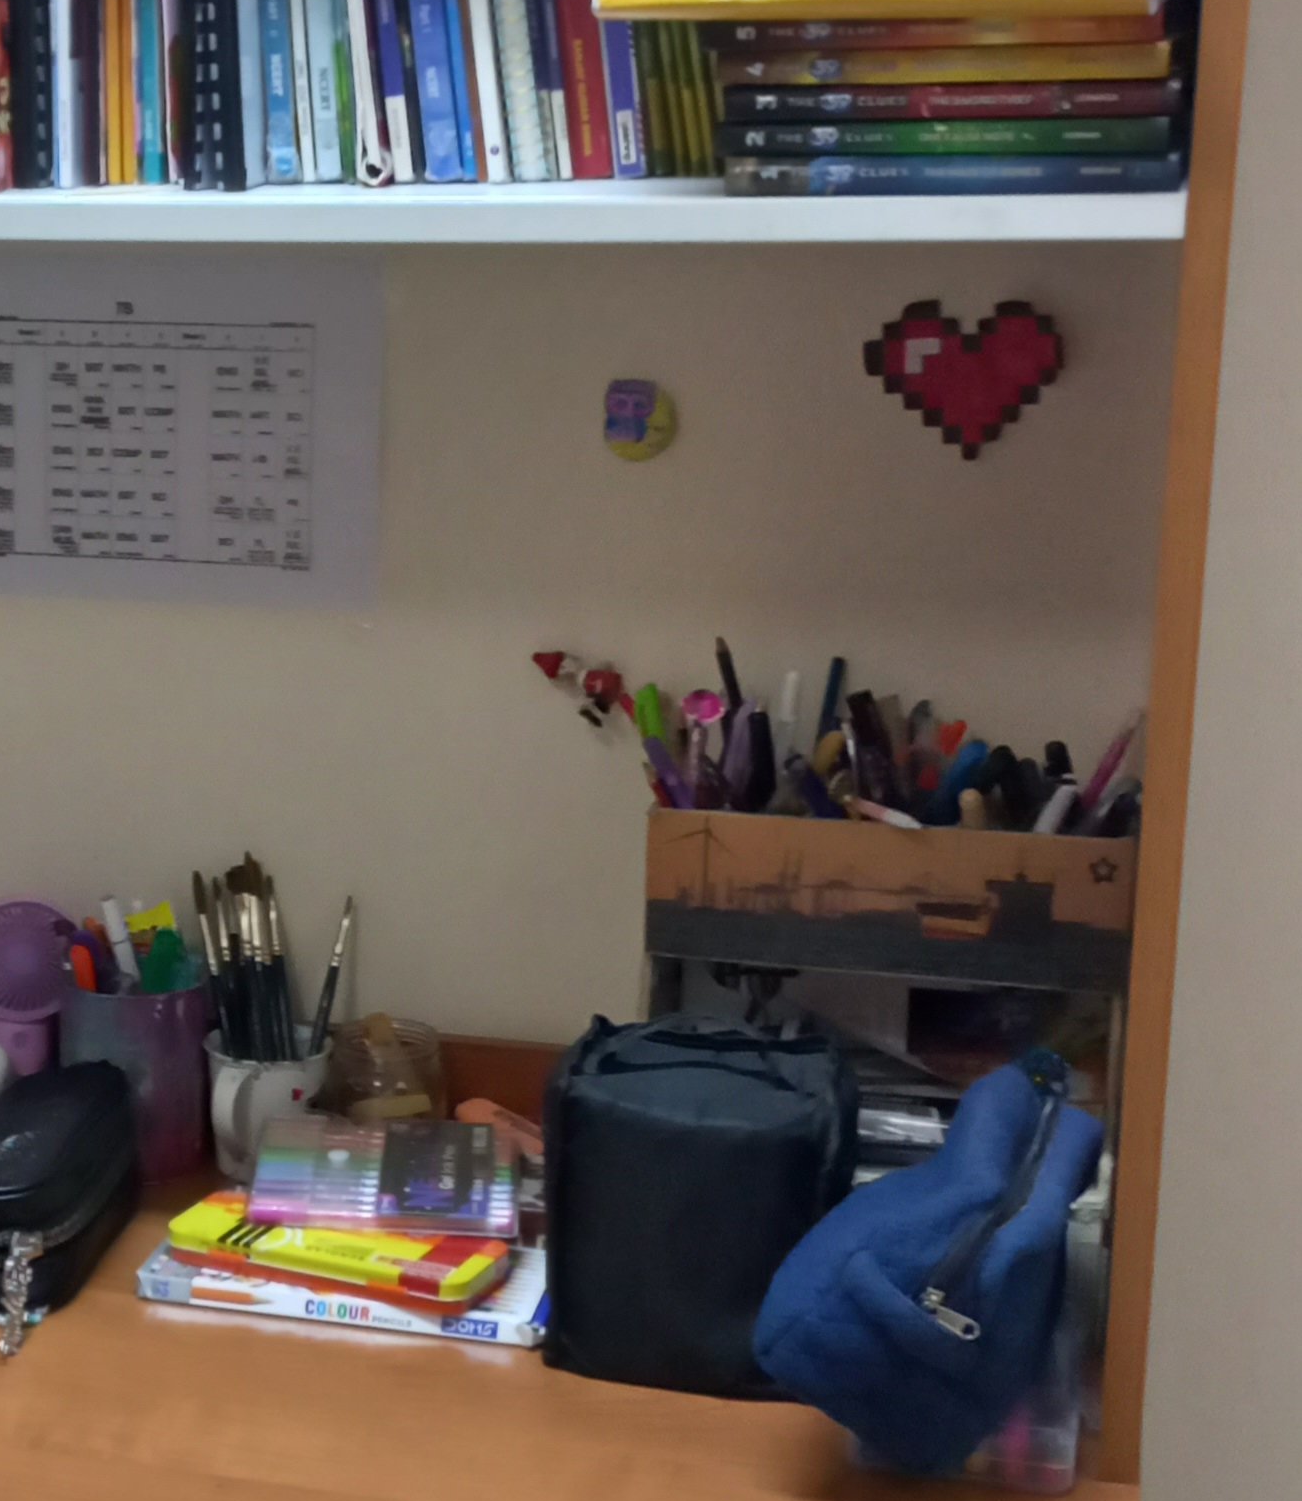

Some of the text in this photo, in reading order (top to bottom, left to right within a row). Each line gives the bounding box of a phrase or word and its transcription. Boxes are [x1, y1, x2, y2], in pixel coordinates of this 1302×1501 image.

[803, 23, 832, 39] 39
[812, 60, 841, 77] 39
[318, 67, 332, 112] NCERT
[857, 96, 908, 107] CLUES
[745, 131, 766, 146] 2
[811, 127, 840, 146] 39
[305, 1298, 371, 1321] COLOUR
